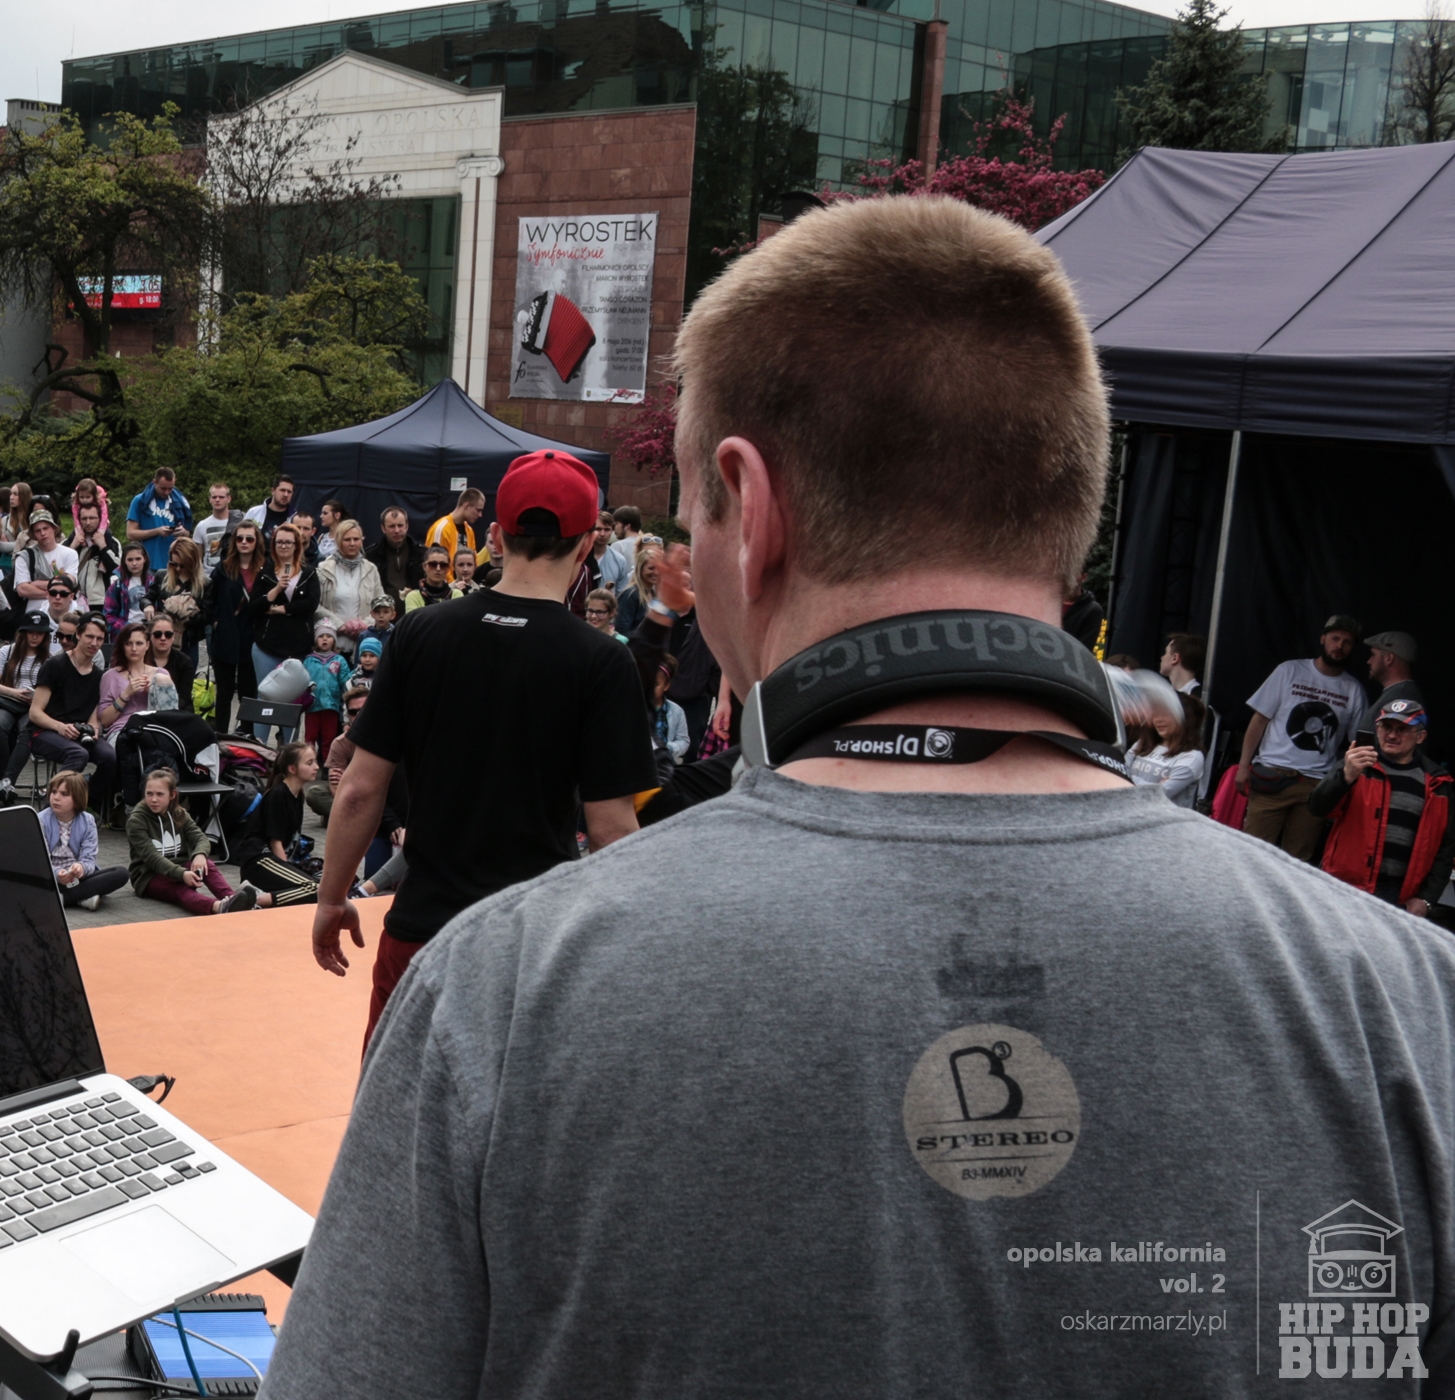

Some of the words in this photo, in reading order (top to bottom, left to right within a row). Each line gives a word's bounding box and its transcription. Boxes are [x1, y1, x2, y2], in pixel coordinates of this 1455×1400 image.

[526, 220, 653, 243] WYROSTEK
[793, 616, 1098, 695] Technics
[916, 1130, 1075, 1152] STEREO
